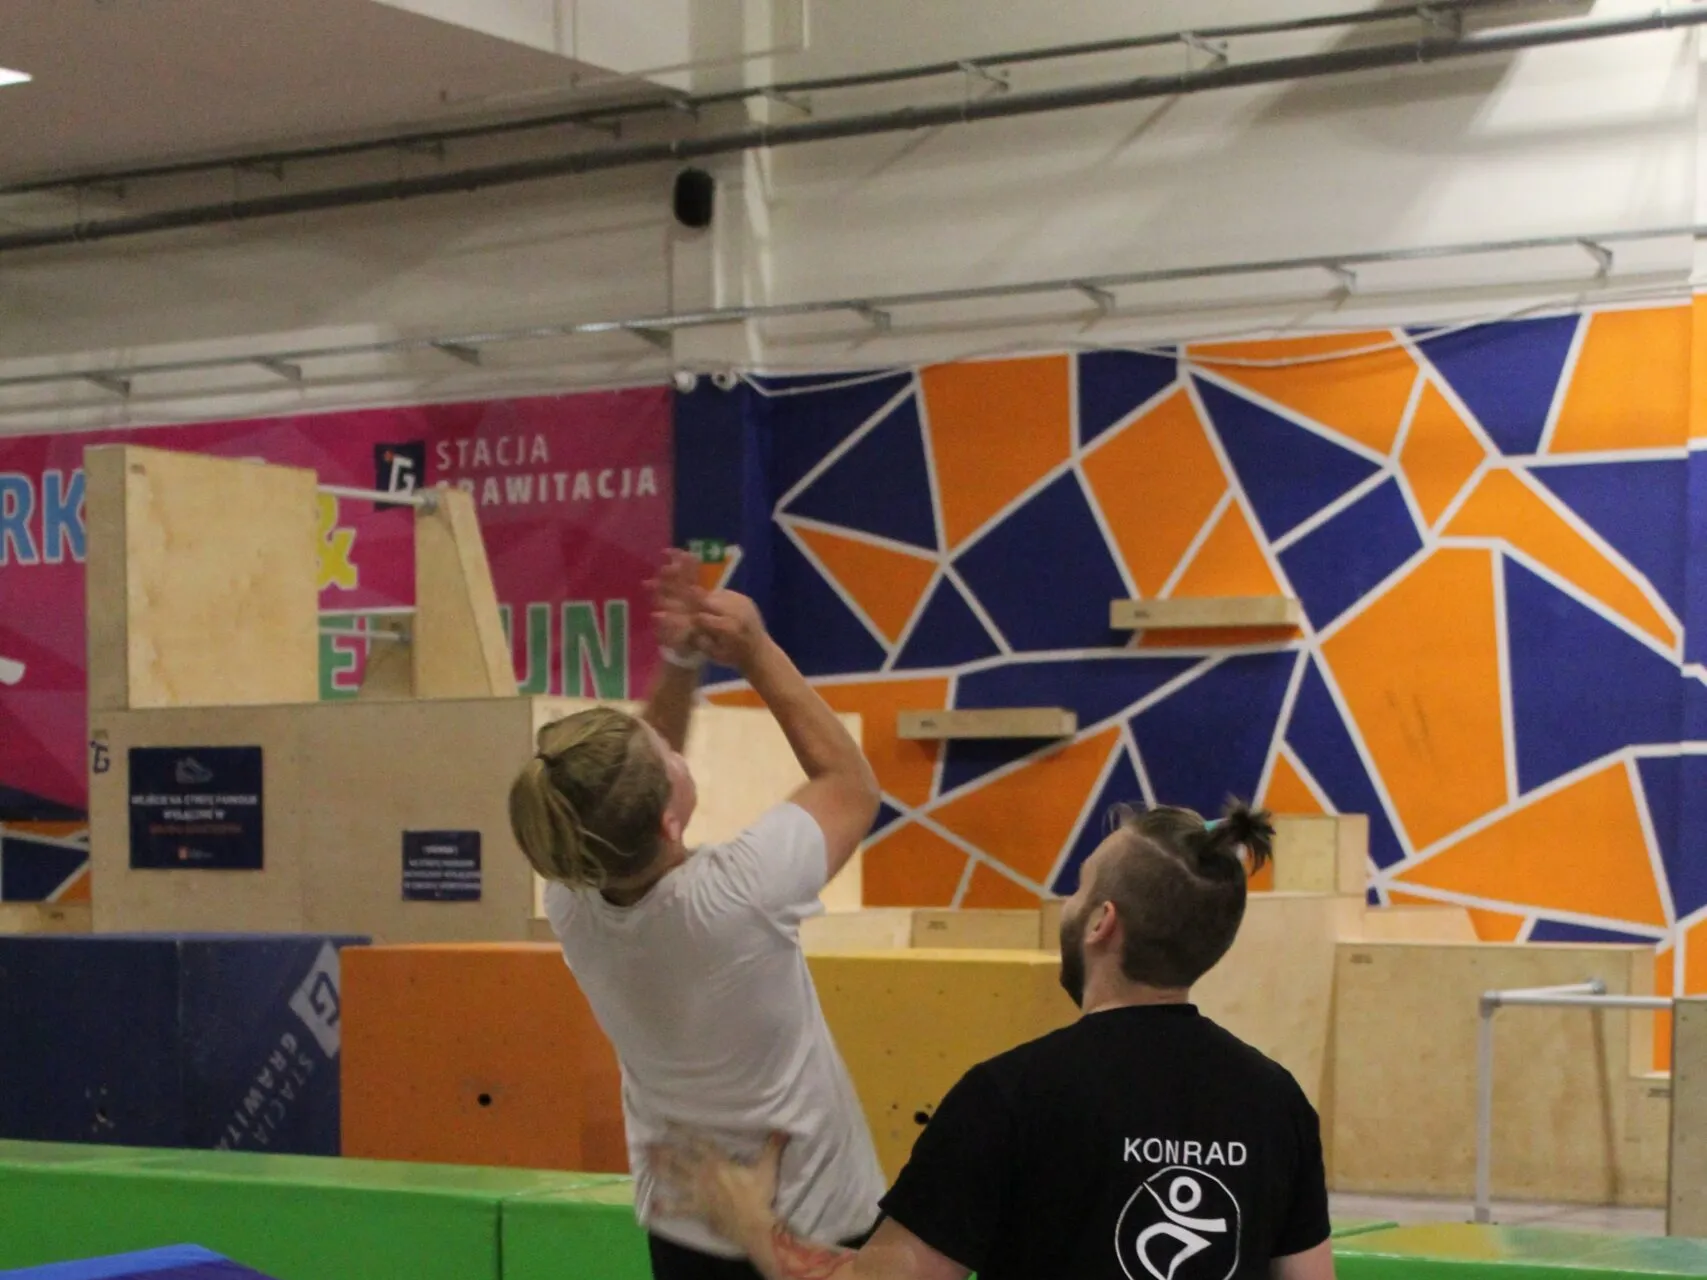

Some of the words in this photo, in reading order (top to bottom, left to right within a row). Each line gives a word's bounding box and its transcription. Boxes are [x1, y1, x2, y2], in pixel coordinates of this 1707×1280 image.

[435, 433, 551, 471] STACJA
[436, 467, 658, 506] AWITACJA
[1123, 1136, 1248, 1166] KONRAD
